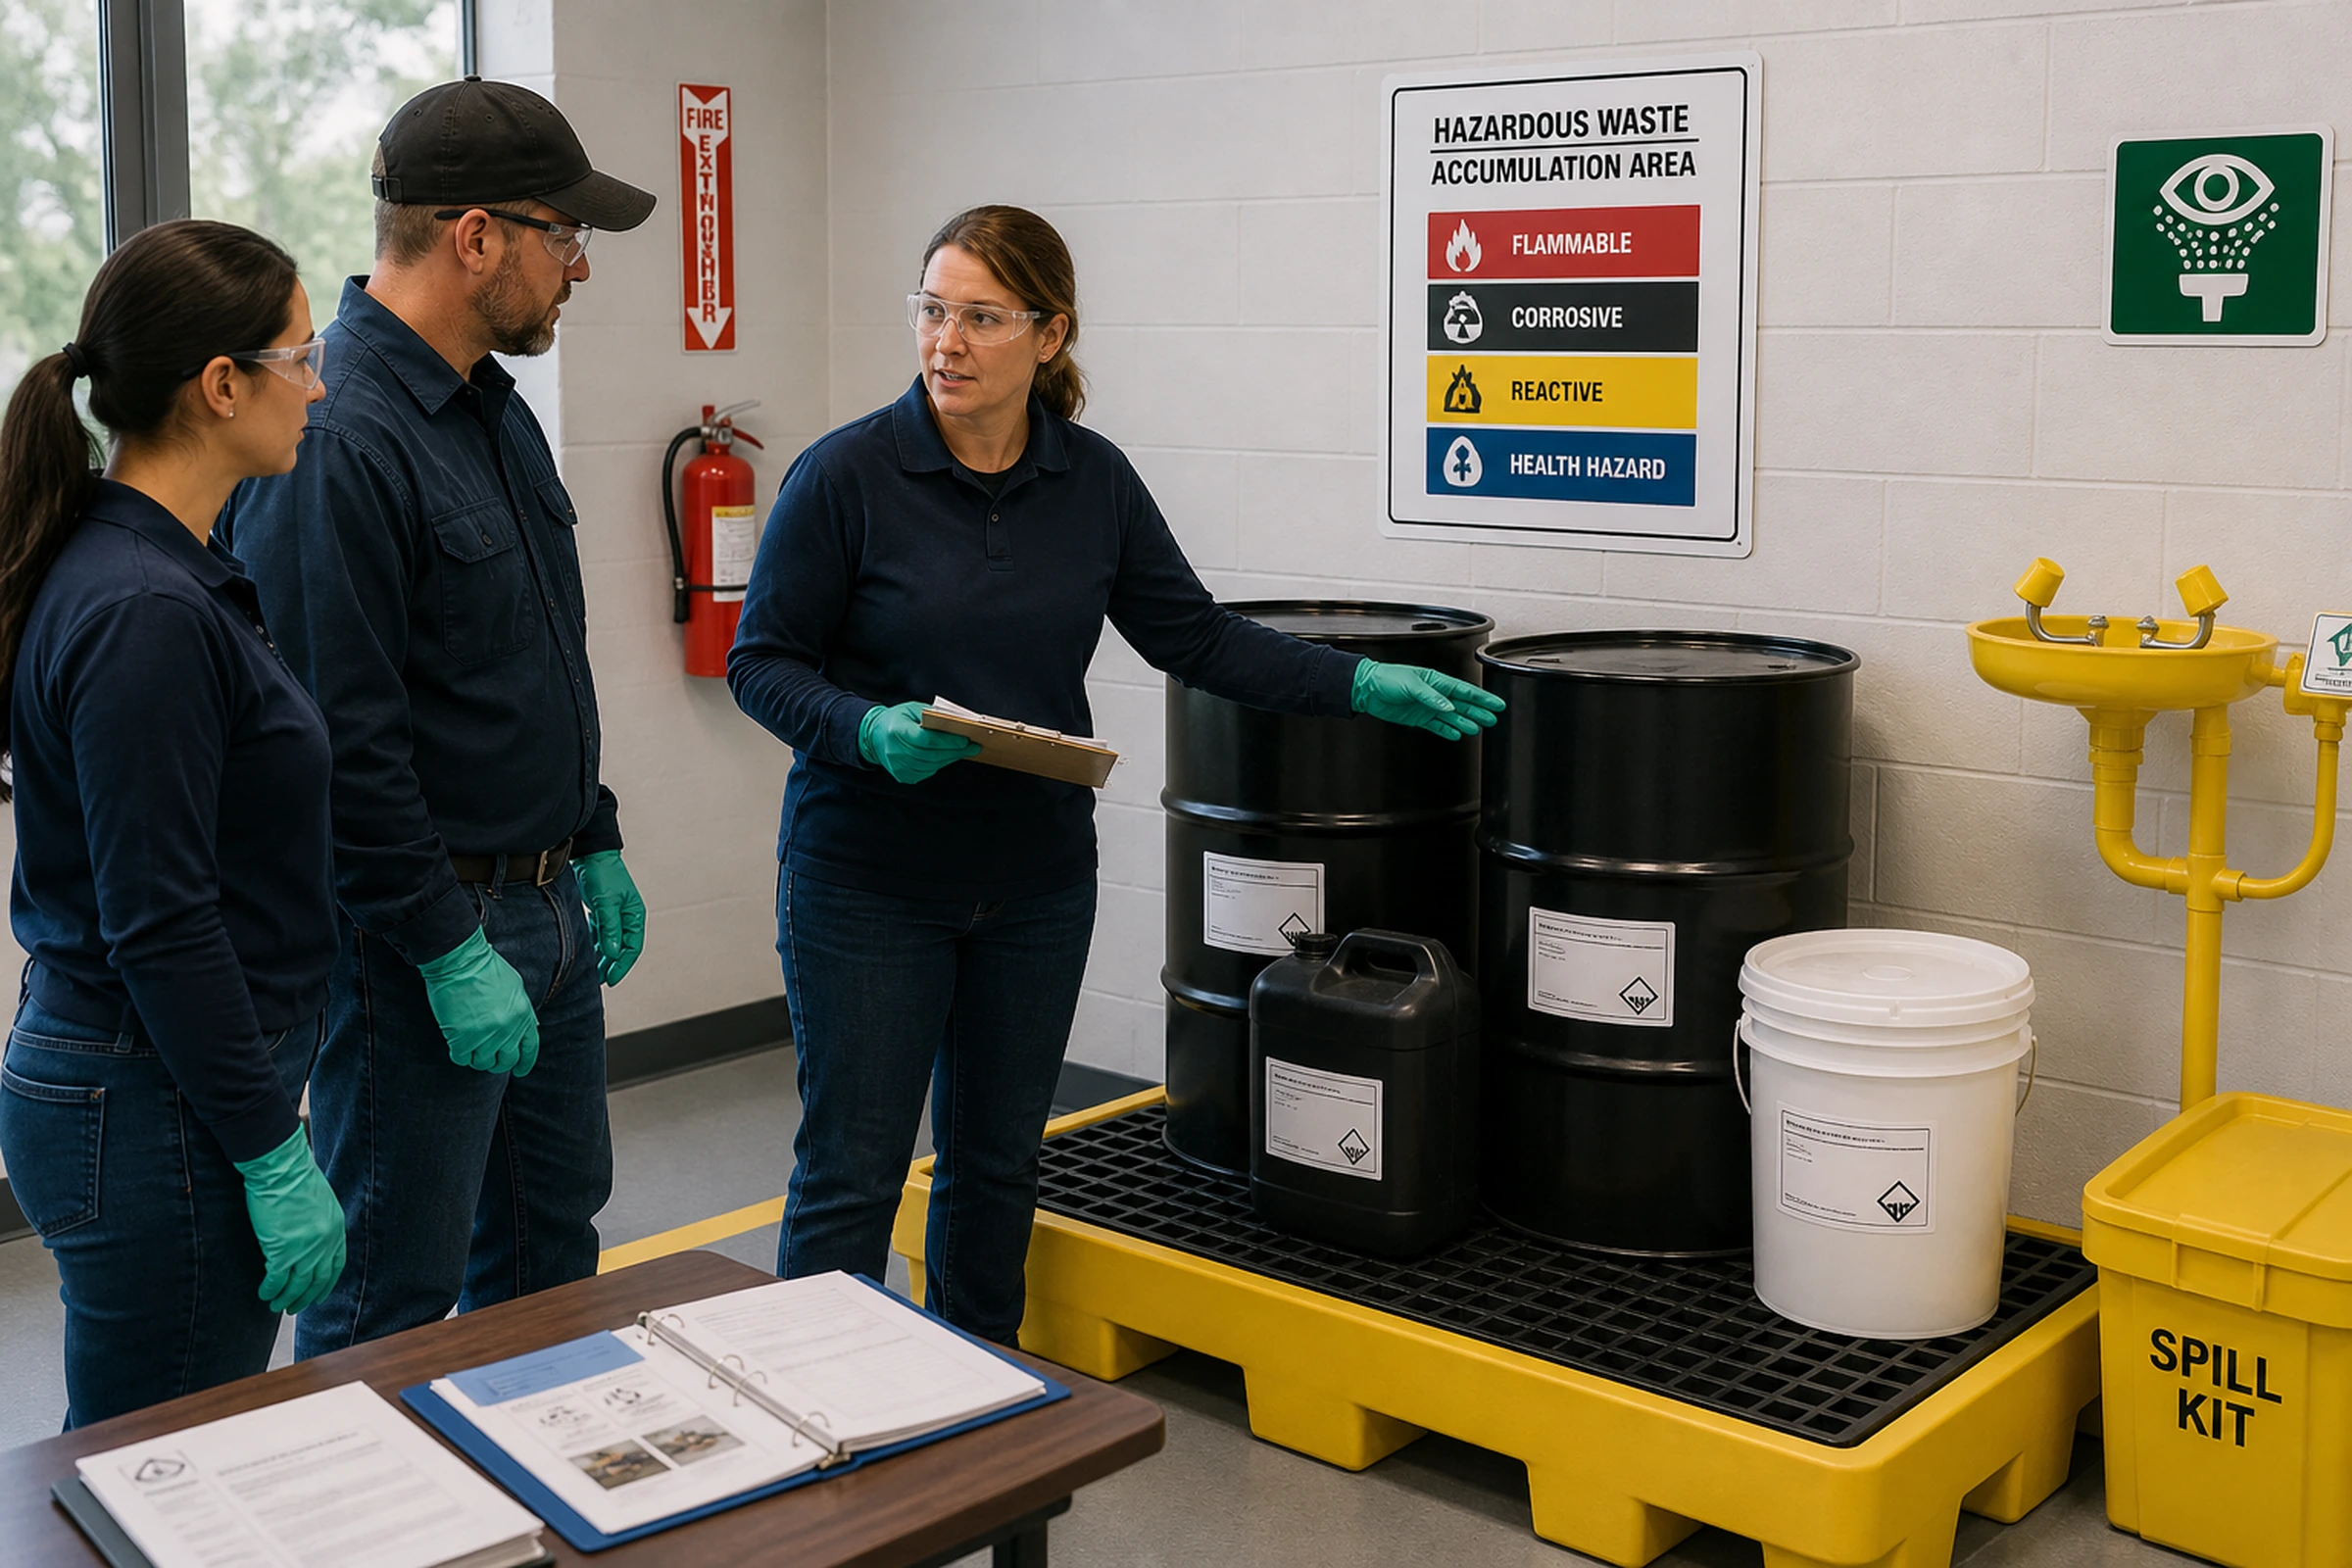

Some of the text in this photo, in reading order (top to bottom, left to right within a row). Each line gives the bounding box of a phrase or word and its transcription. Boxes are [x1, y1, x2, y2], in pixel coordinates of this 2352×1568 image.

[686, 107, 724, 130] FIRE
[1434, 104, 1689, 144] HAZARDOUS WASTE
[1431, 150, 1696, 185] ACCUMULATION AREA
[1512, 231, 1632, 256] FLAMMABLE
[1511, 306, 1623, 328] CORROSIVE
[1511, 380, 1603, 403] REACTIVE
[1510, 454, 1666, 480] HEALTH HAZARD
[2150, 1328, 2282, 1404] SPILL
[2178, 1388, 2255, 1447] KIT
